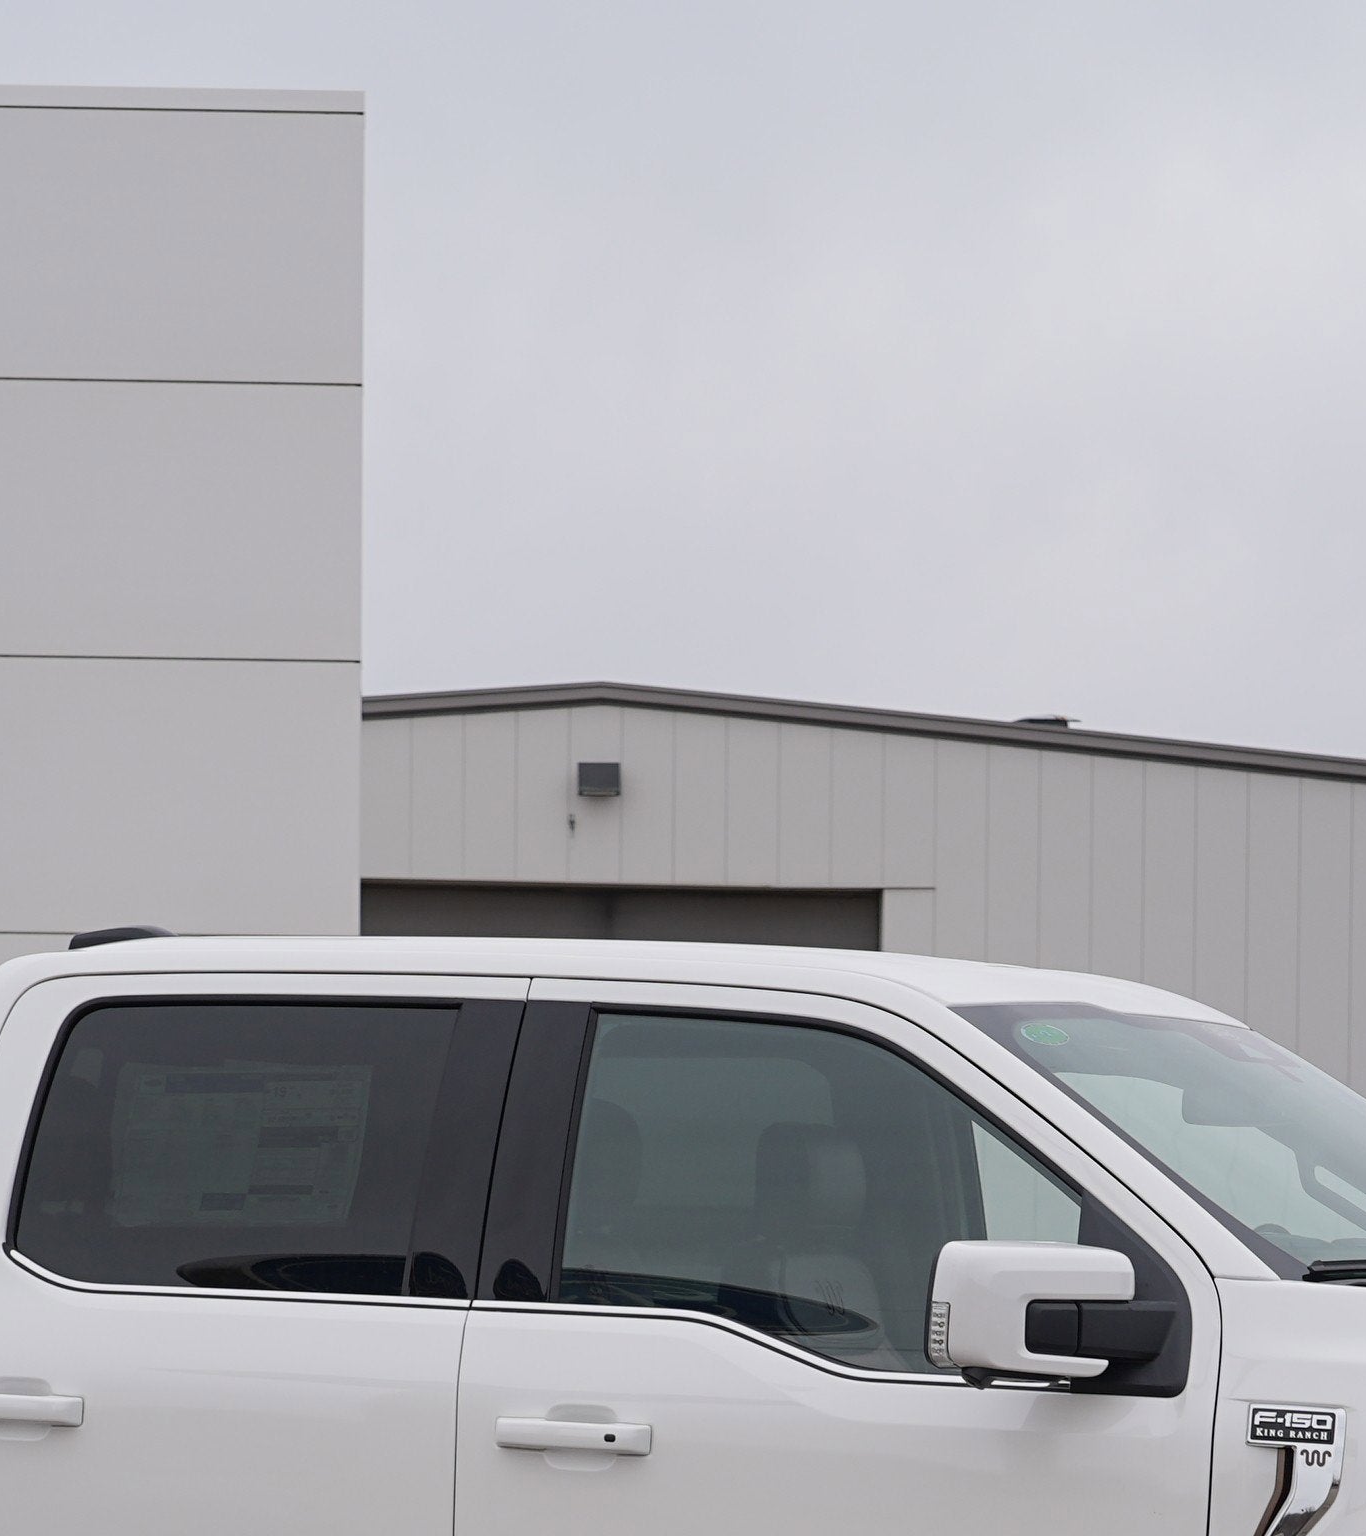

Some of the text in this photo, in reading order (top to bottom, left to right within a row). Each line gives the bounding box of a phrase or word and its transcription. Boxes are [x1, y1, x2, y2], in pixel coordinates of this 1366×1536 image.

[1253, 1411, 1334, 1430] F-150
[1256, 1427, 1328, 1440] KING RANCH
